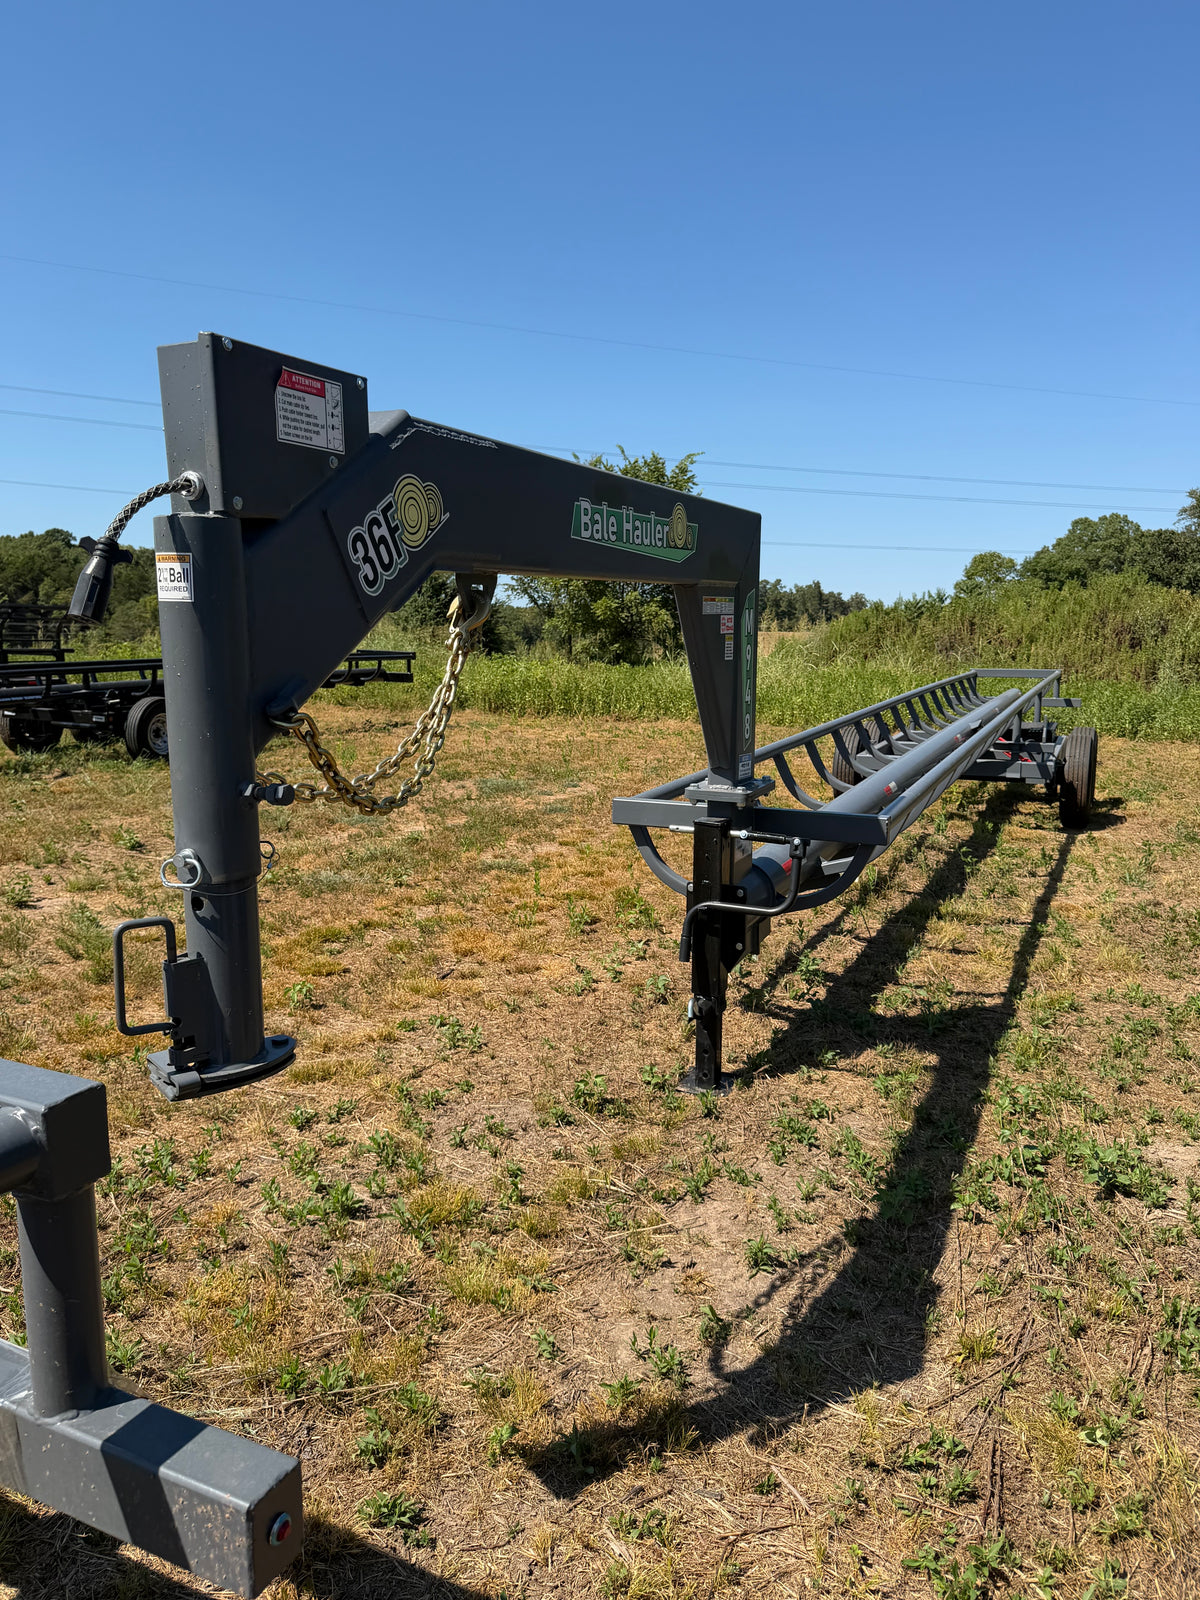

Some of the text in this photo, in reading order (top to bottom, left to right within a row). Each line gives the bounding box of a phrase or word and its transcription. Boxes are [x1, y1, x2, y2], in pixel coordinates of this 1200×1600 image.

[291, 375, 321, 388] ATTENTION
[580, 499, 670, 548] Bale Hauler
[349, 497, 405, 591] 36F
[169, 567, 189, 583] Ball
[159, 585, 188, 593] REQUIRED
